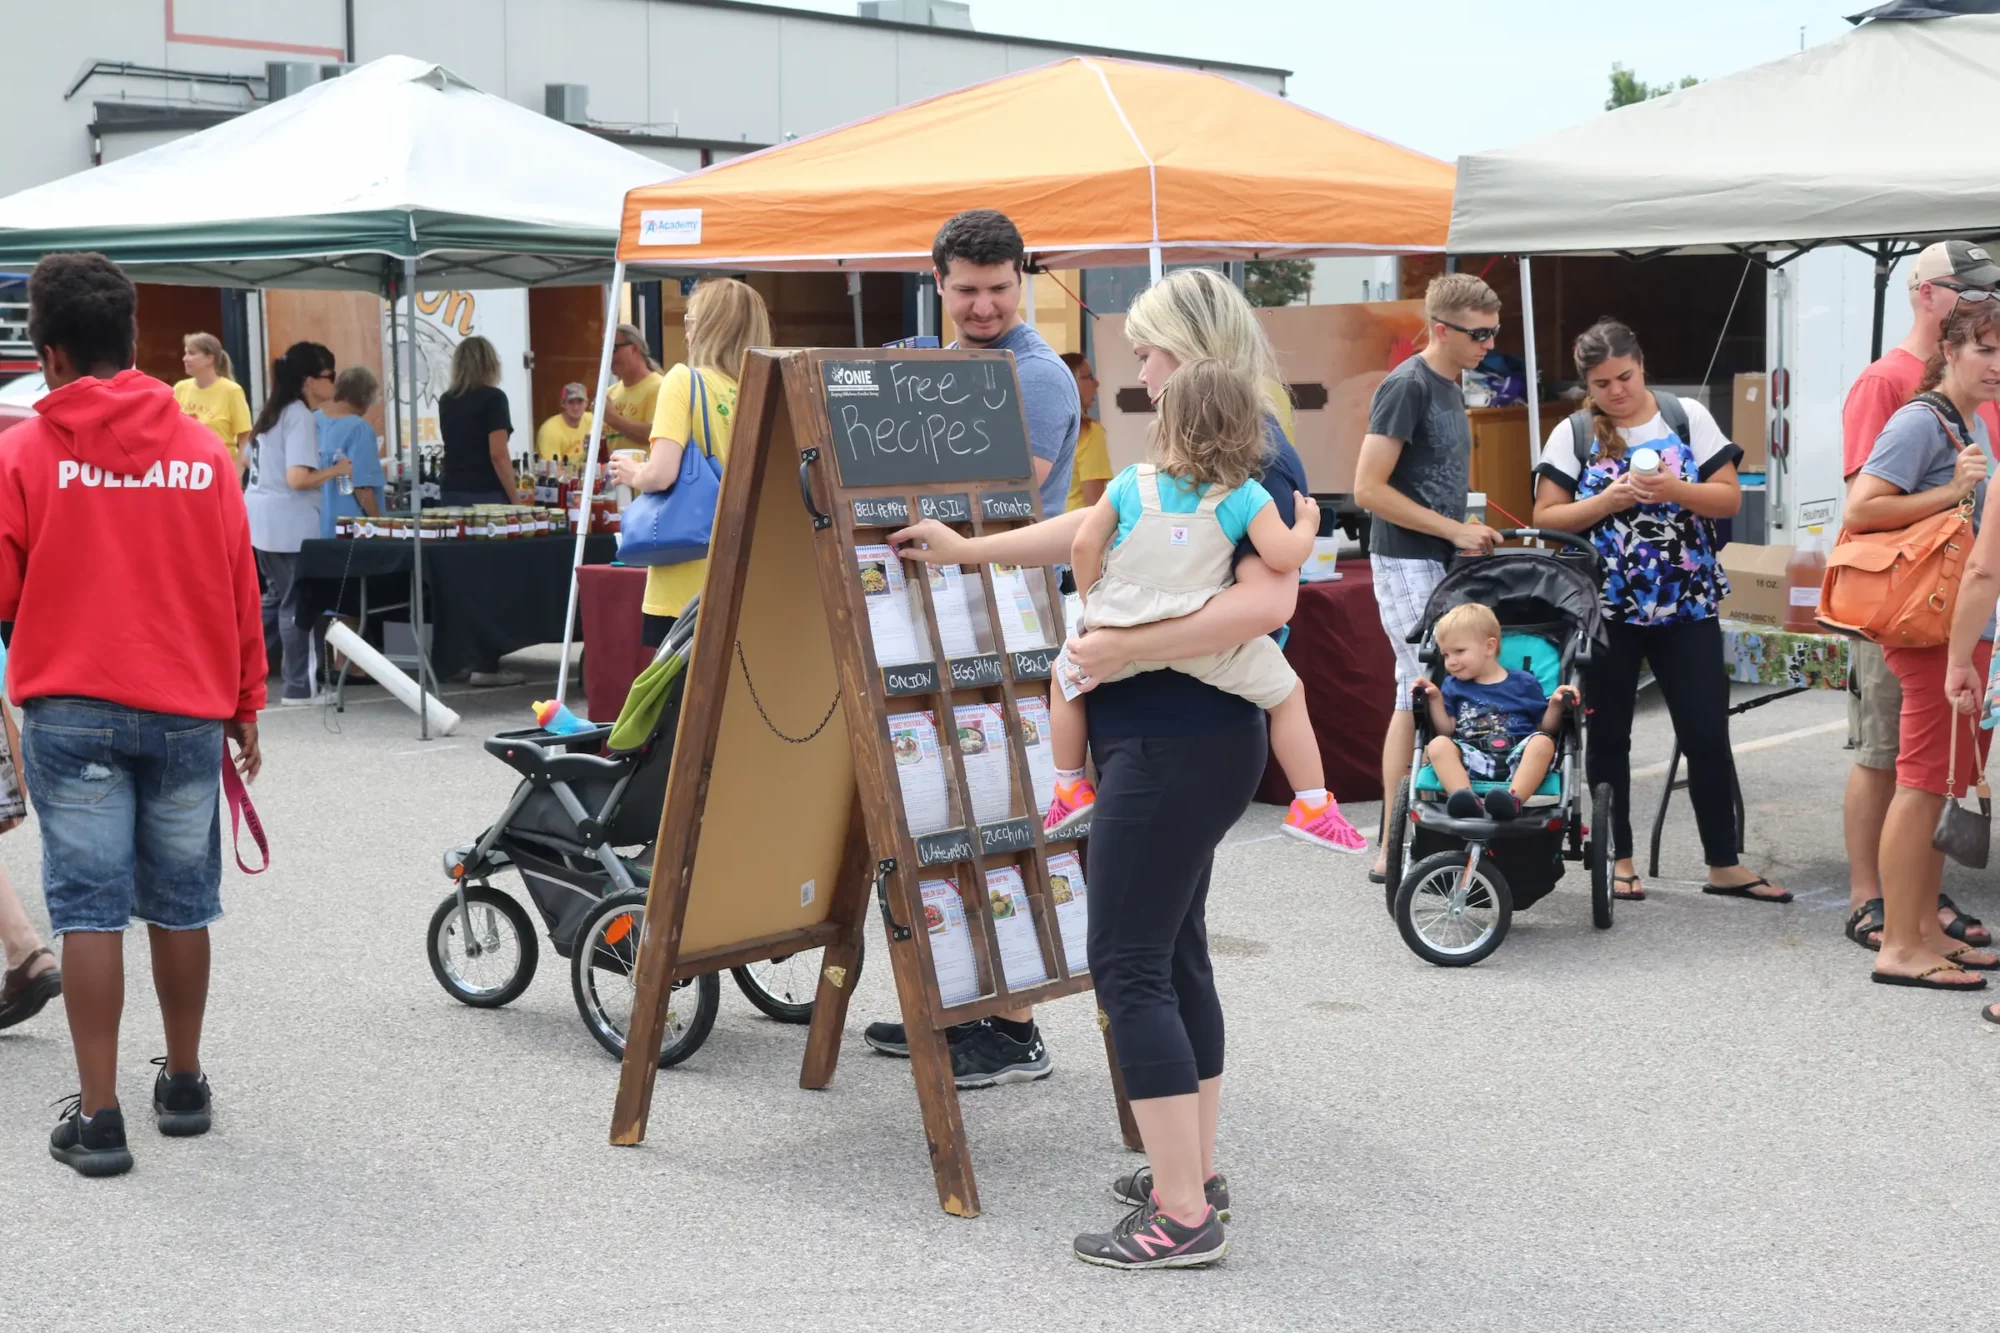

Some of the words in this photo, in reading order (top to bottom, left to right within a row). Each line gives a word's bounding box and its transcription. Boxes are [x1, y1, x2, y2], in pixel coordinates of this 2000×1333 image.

[659, 220, 697, 231] Academy
[844, 369, 873, 385] ONIE
[890, 362, 971, 405] Free
[841, 404, 990, 464] Recipes
[921, 498, 967, 520] BASIL
